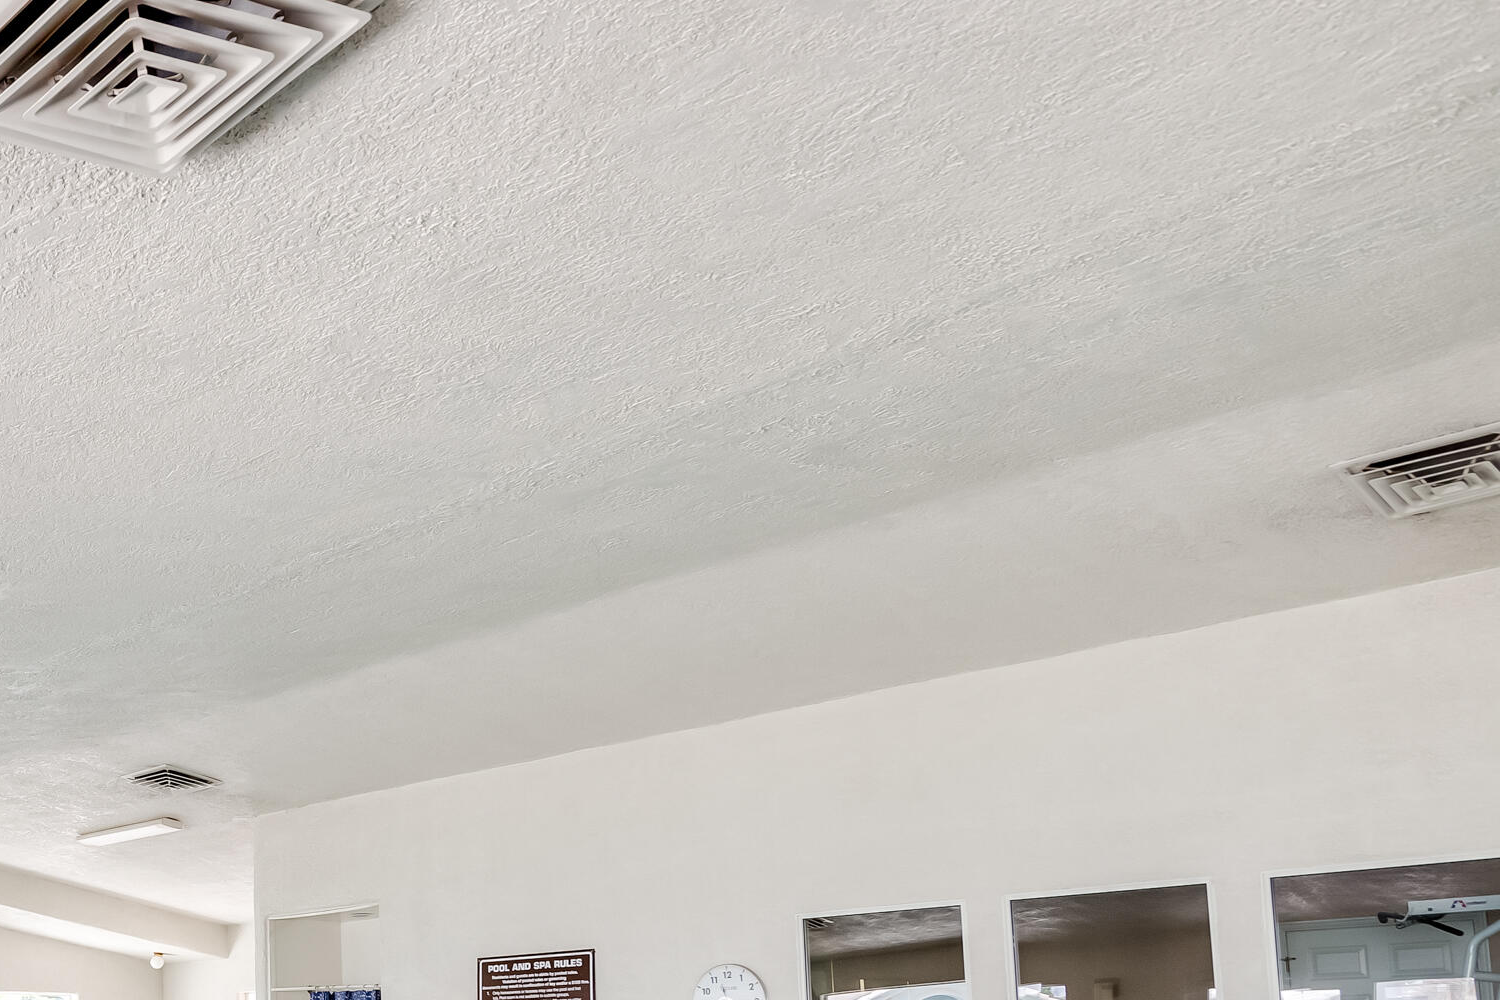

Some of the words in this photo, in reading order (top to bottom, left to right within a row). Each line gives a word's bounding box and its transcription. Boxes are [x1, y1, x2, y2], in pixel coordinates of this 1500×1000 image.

[488, 964, 510, 973] POOL
[512, 962, 531, 971] AND
[534, 960, 551, 970] SPA
[554, 958, 582, 968] RULES
